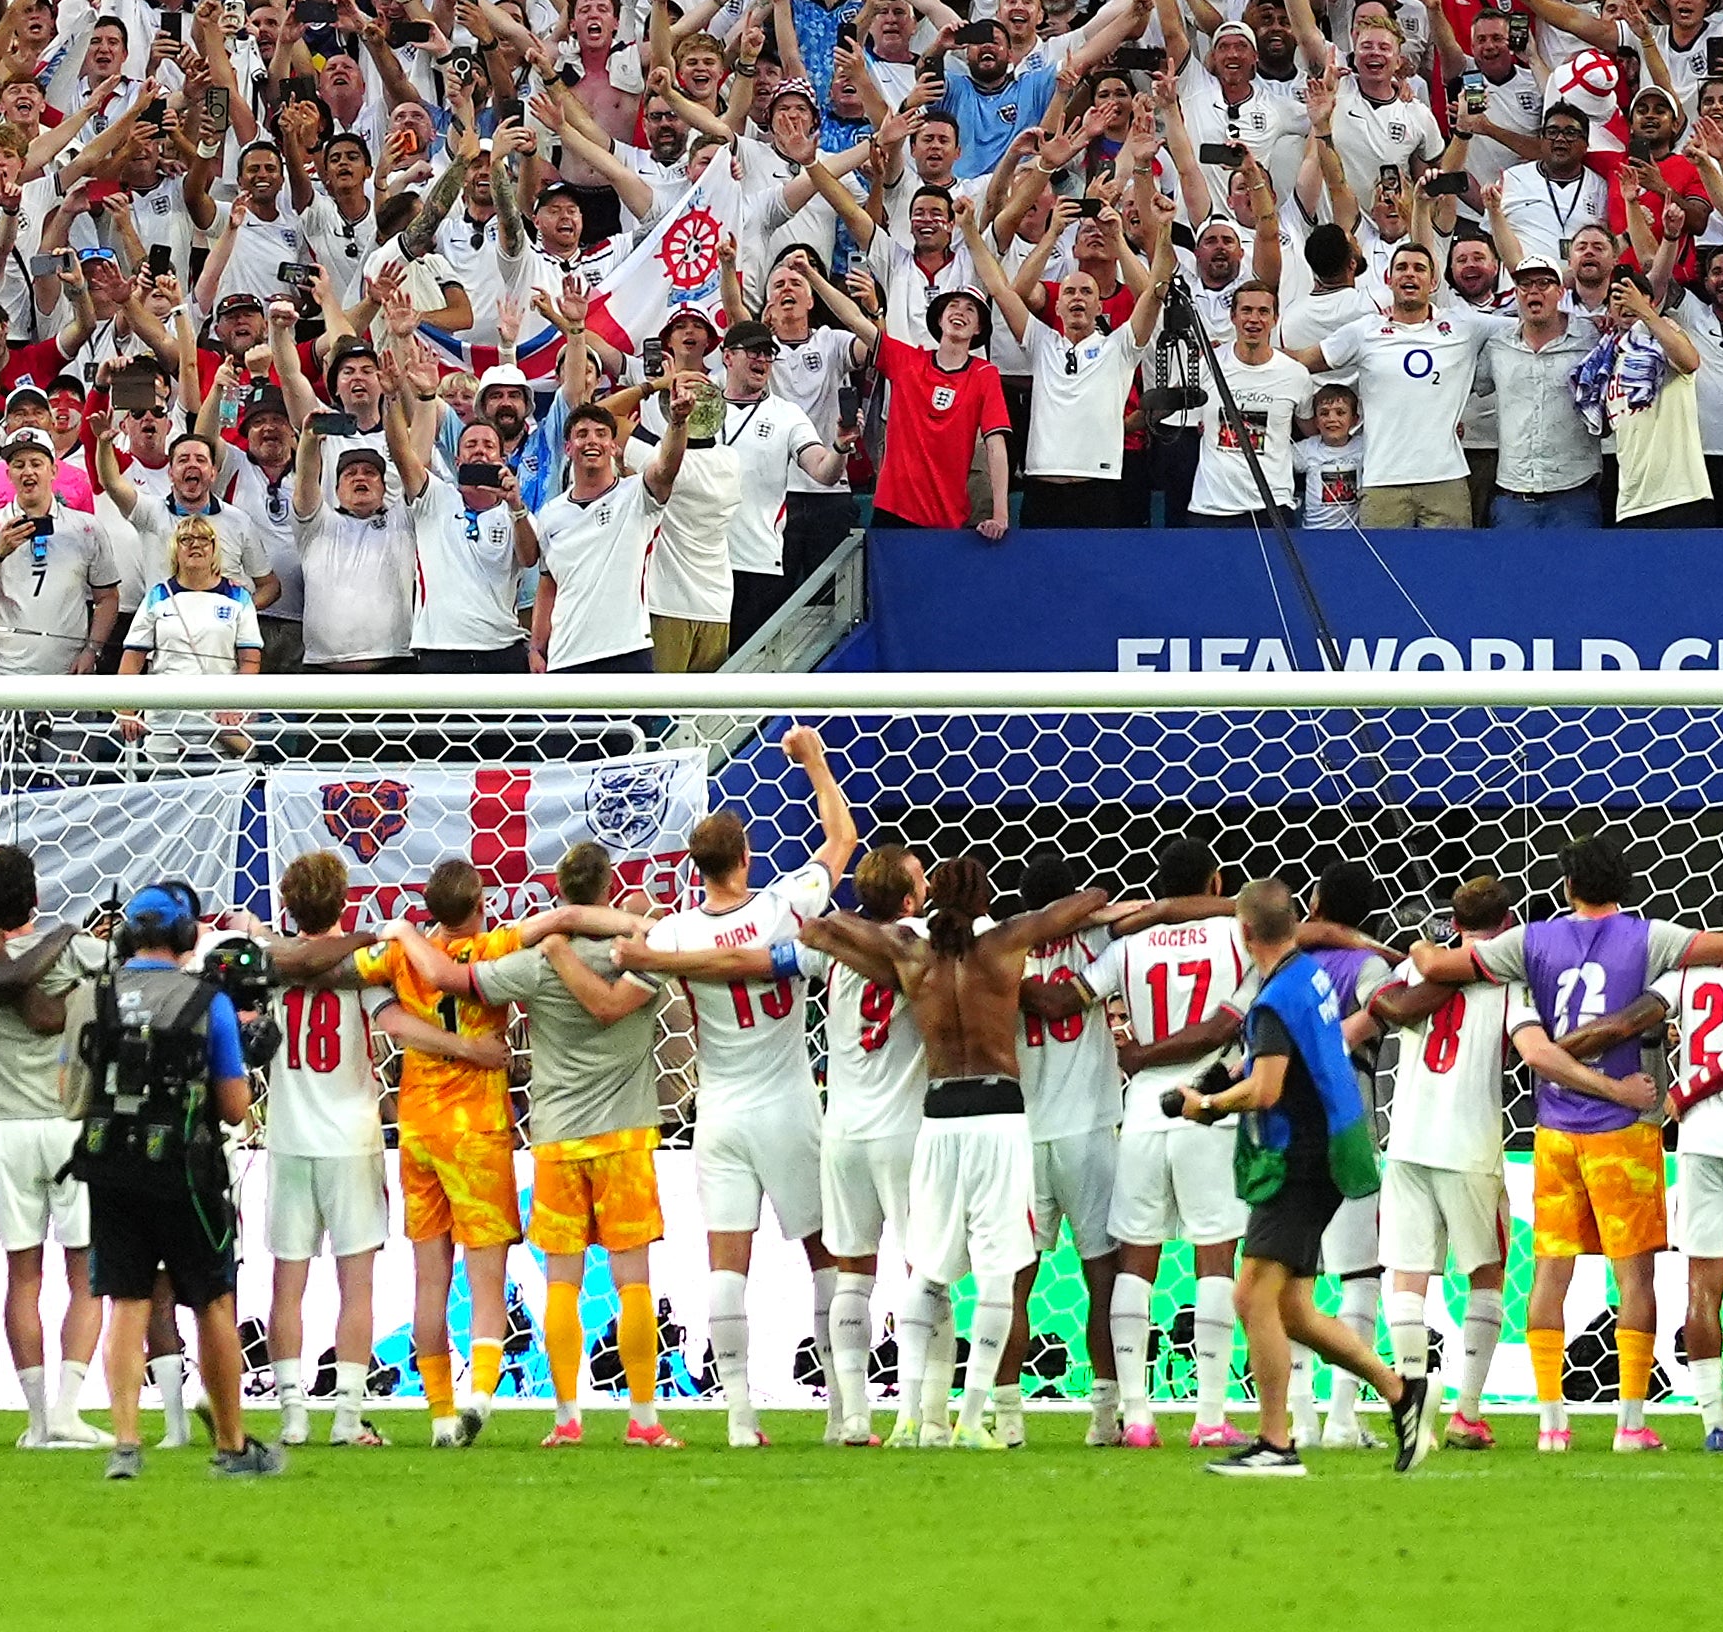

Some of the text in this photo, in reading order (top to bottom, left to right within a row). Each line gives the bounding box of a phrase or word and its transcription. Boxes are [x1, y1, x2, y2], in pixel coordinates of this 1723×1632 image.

[32, 570, 47, 598] 7
[1148, 928, 1207, 948] ROGERS
[282, 989, 341, 1072] 18
[1146, 960, 1212, 1045] 17
[1424, 992, 1466, 1074] 8
